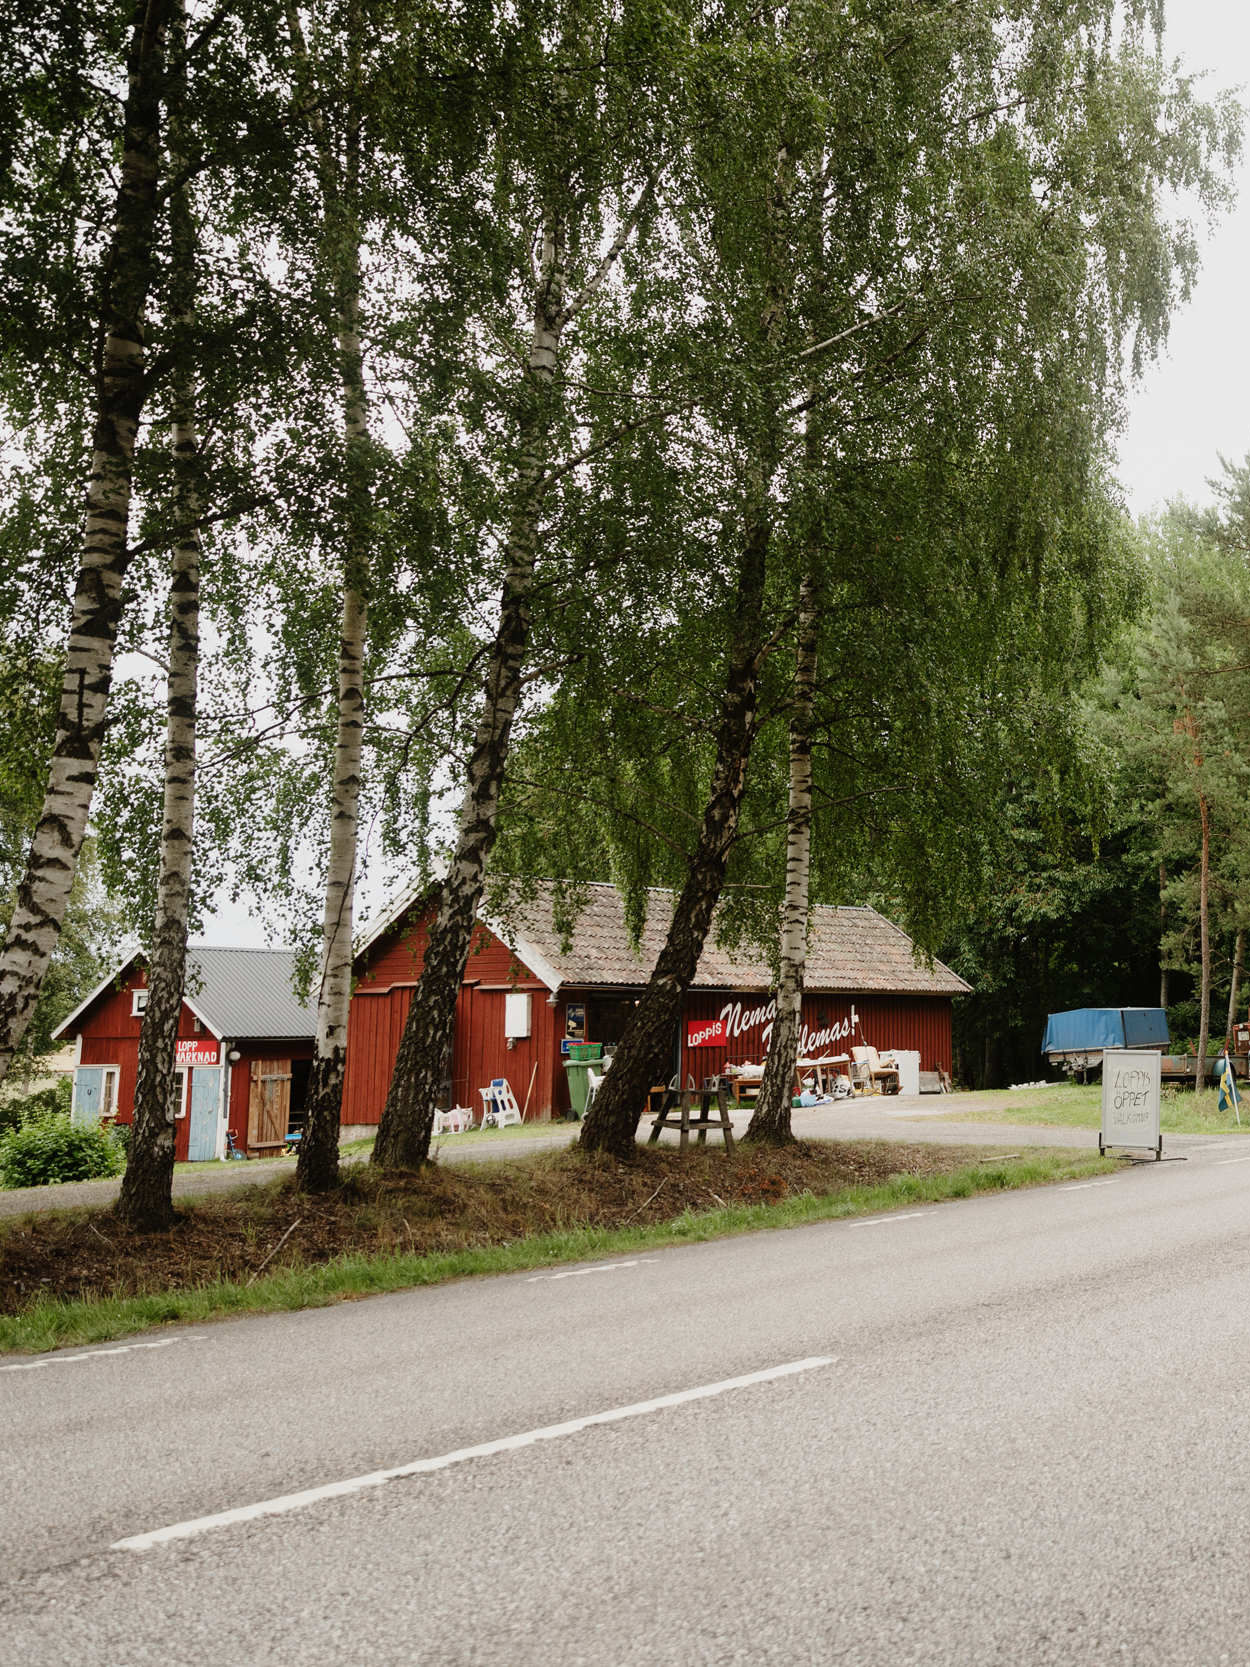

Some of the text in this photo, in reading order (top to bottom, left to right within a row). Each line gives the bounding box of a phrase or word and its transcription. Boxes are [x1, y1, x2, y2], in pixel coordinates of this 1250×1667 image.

[178, 1041, 198, 1052] LOPP
[1114, 1070, 1151, 1088] LOPPIS
[1113, 1090, 1150, 1109] ÖPPET
